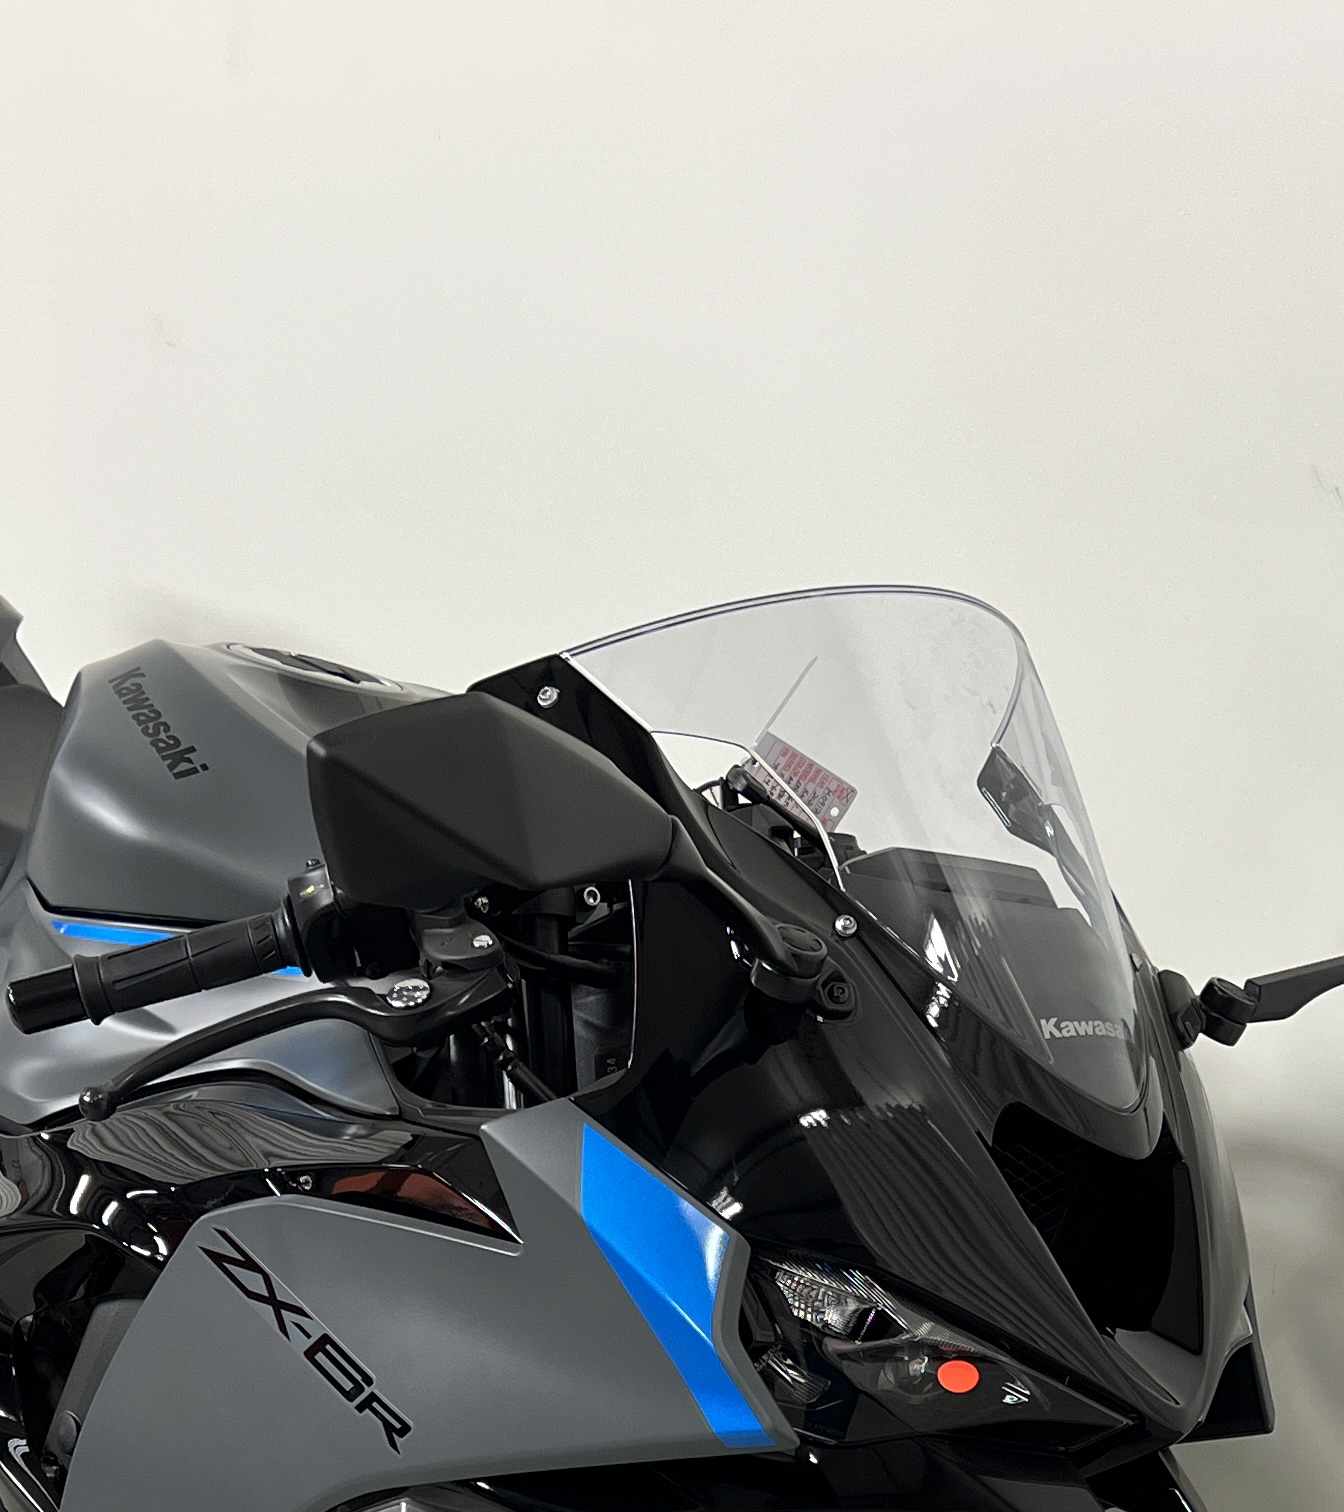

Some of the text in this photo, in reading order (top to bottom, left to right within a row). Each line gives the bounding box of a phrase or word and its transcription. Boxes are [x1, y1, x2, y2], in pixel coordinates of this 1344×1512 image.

[108, 667, 209, 780] Kawasaki
[1039, 1016, 1127, 1041] Kawasa
[198, 1227, 412, 1456] ZX-6R
